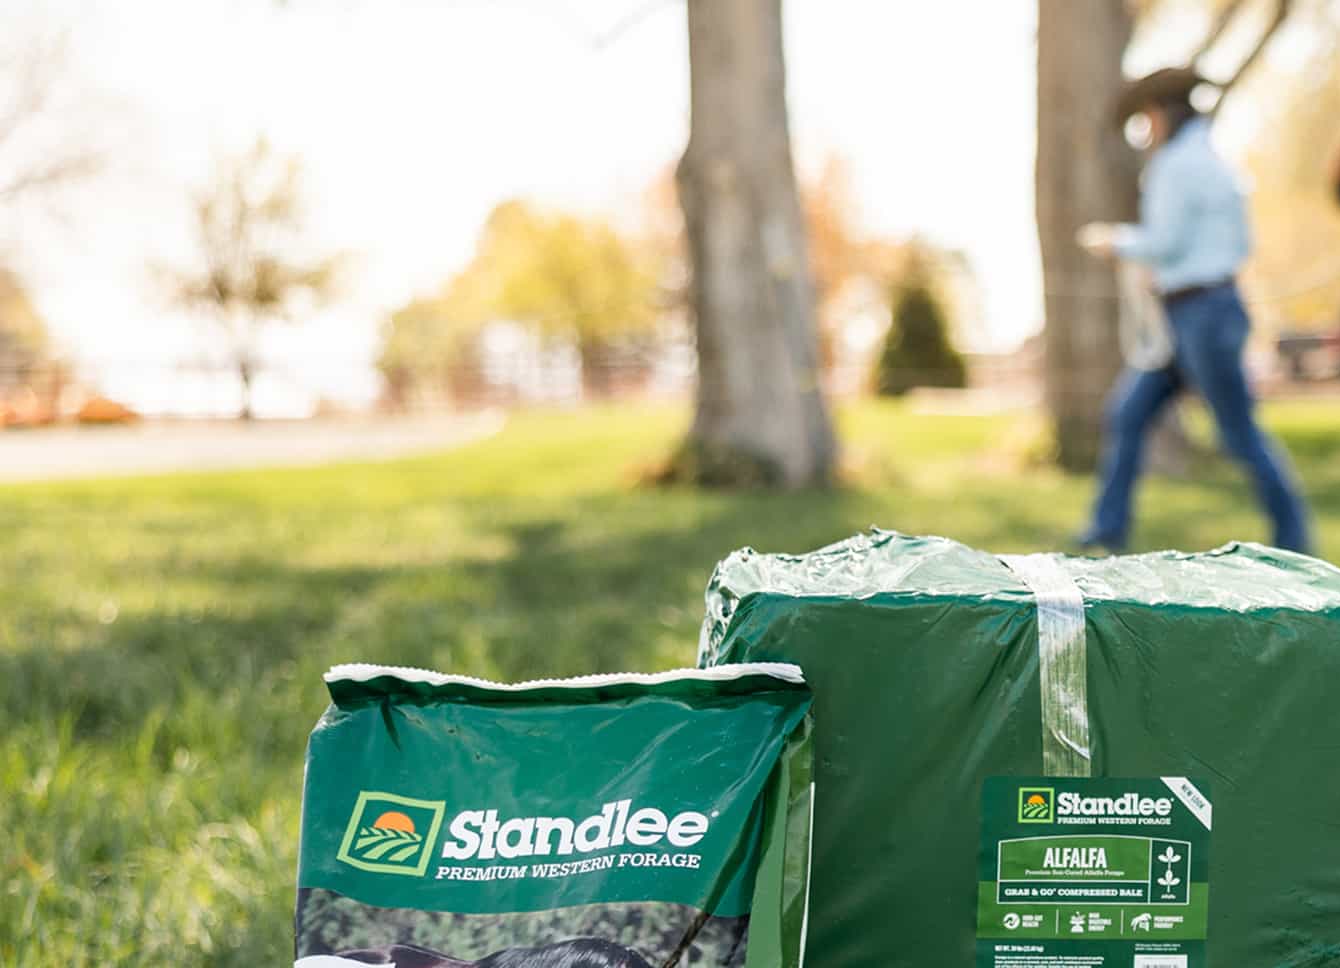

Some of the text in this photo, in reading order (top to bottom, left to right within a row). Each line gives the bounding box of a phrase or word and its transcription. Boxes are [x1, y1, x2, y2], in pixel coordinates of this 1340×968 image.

[1057, 792, 1172, 816] Standlee
[441, 799, 709, 861] Standlee
[1057, 817, 1171, 825] PREMIUM WESTERN FORAGE
[435, 852, 701, 882] PREMIUM WESTERN FORAGE
[1043, 847, 1107, 868] ALFALFA
[1004, 888, 1031, 897] GRAB
[1031, 888, 1039, 897] &
[1057, 888, 1118, 897] COMPRESSED
[1119, 888, 1143, 897] BALE
